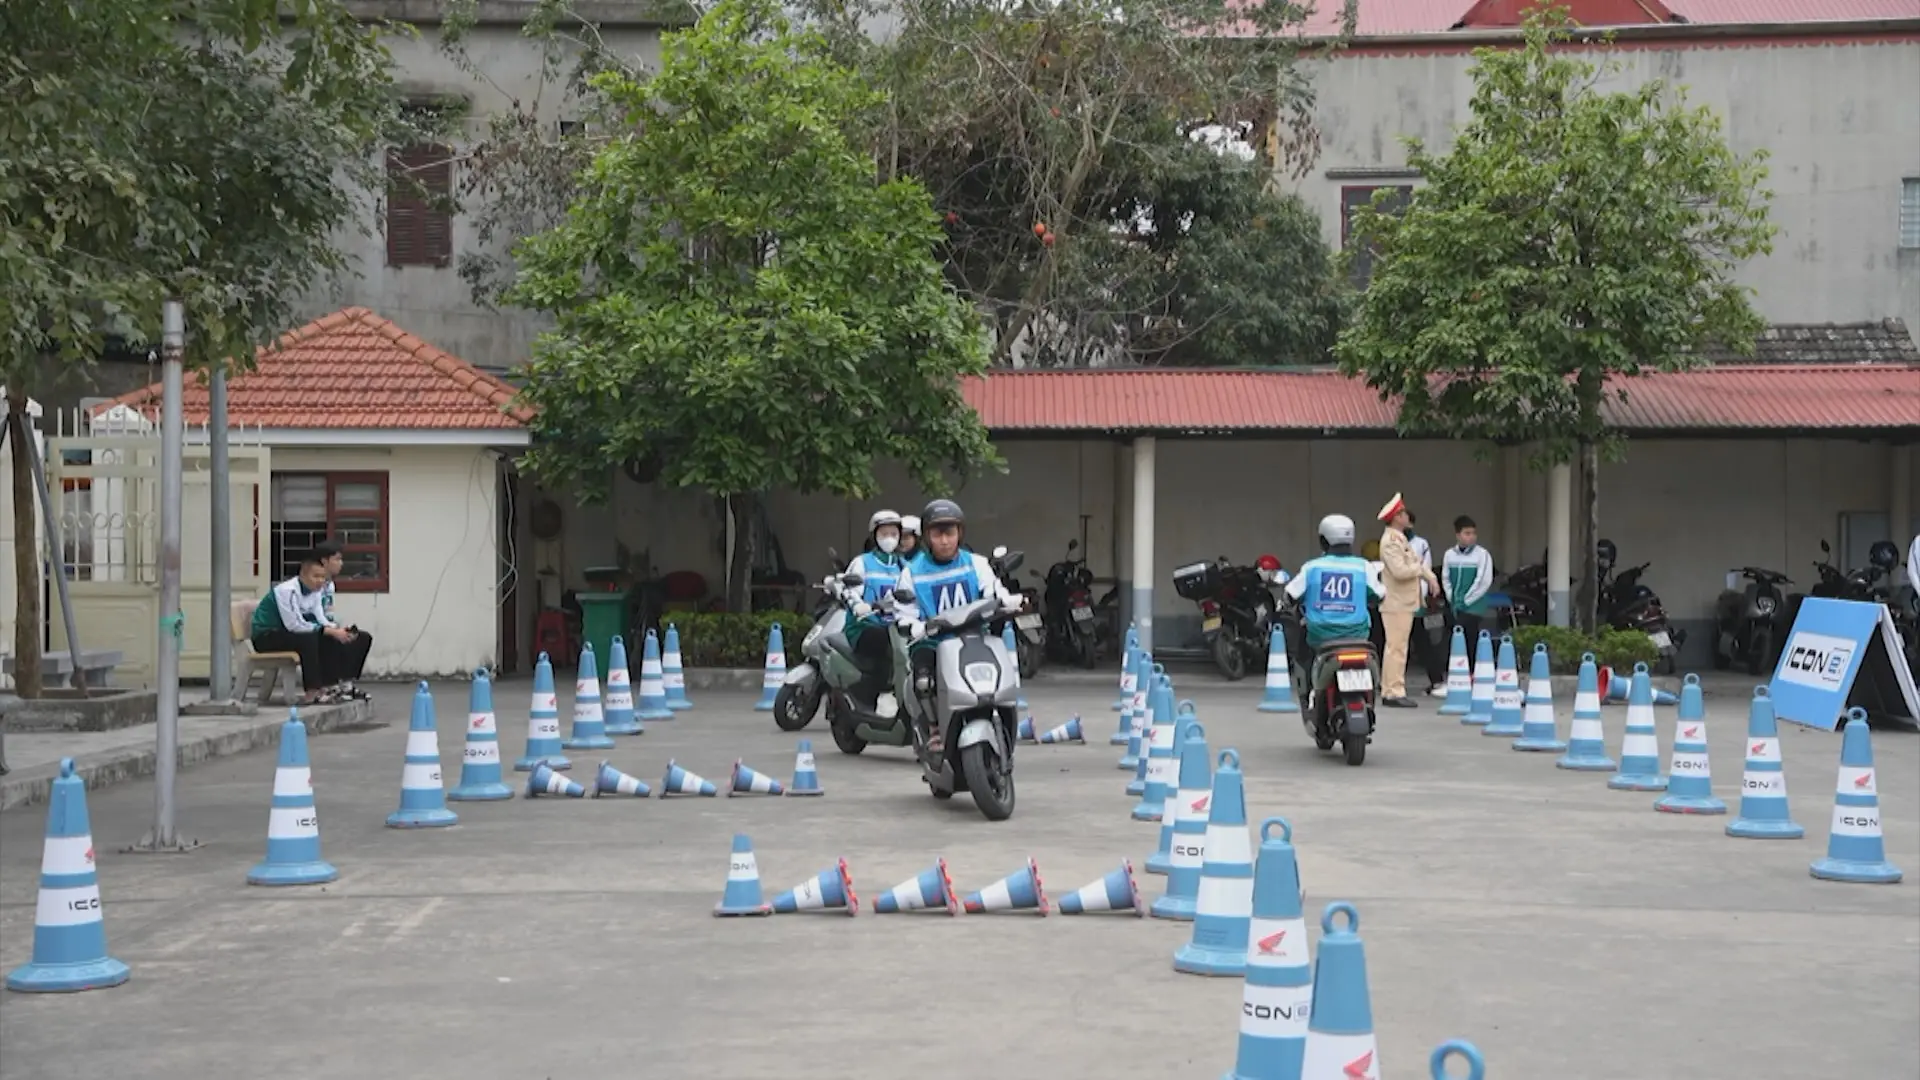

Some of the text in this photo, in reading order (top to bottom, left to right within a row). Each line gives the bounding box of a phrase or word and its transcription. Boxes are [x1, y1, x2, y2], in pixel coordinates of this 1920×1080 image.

[1323, 576, 1351, 599] 40
[1785, 645, 1830, 674] ICON
[1673, 761, 1702, 769] CON
[1743, 779, 1769, 789] CON
[296, 817, 318, 827] ICO
[1839, 815, 1878, 828] ICON
[69, 897, 99, 911] ICO
[1243, 1001, 1292, 1020] CON
